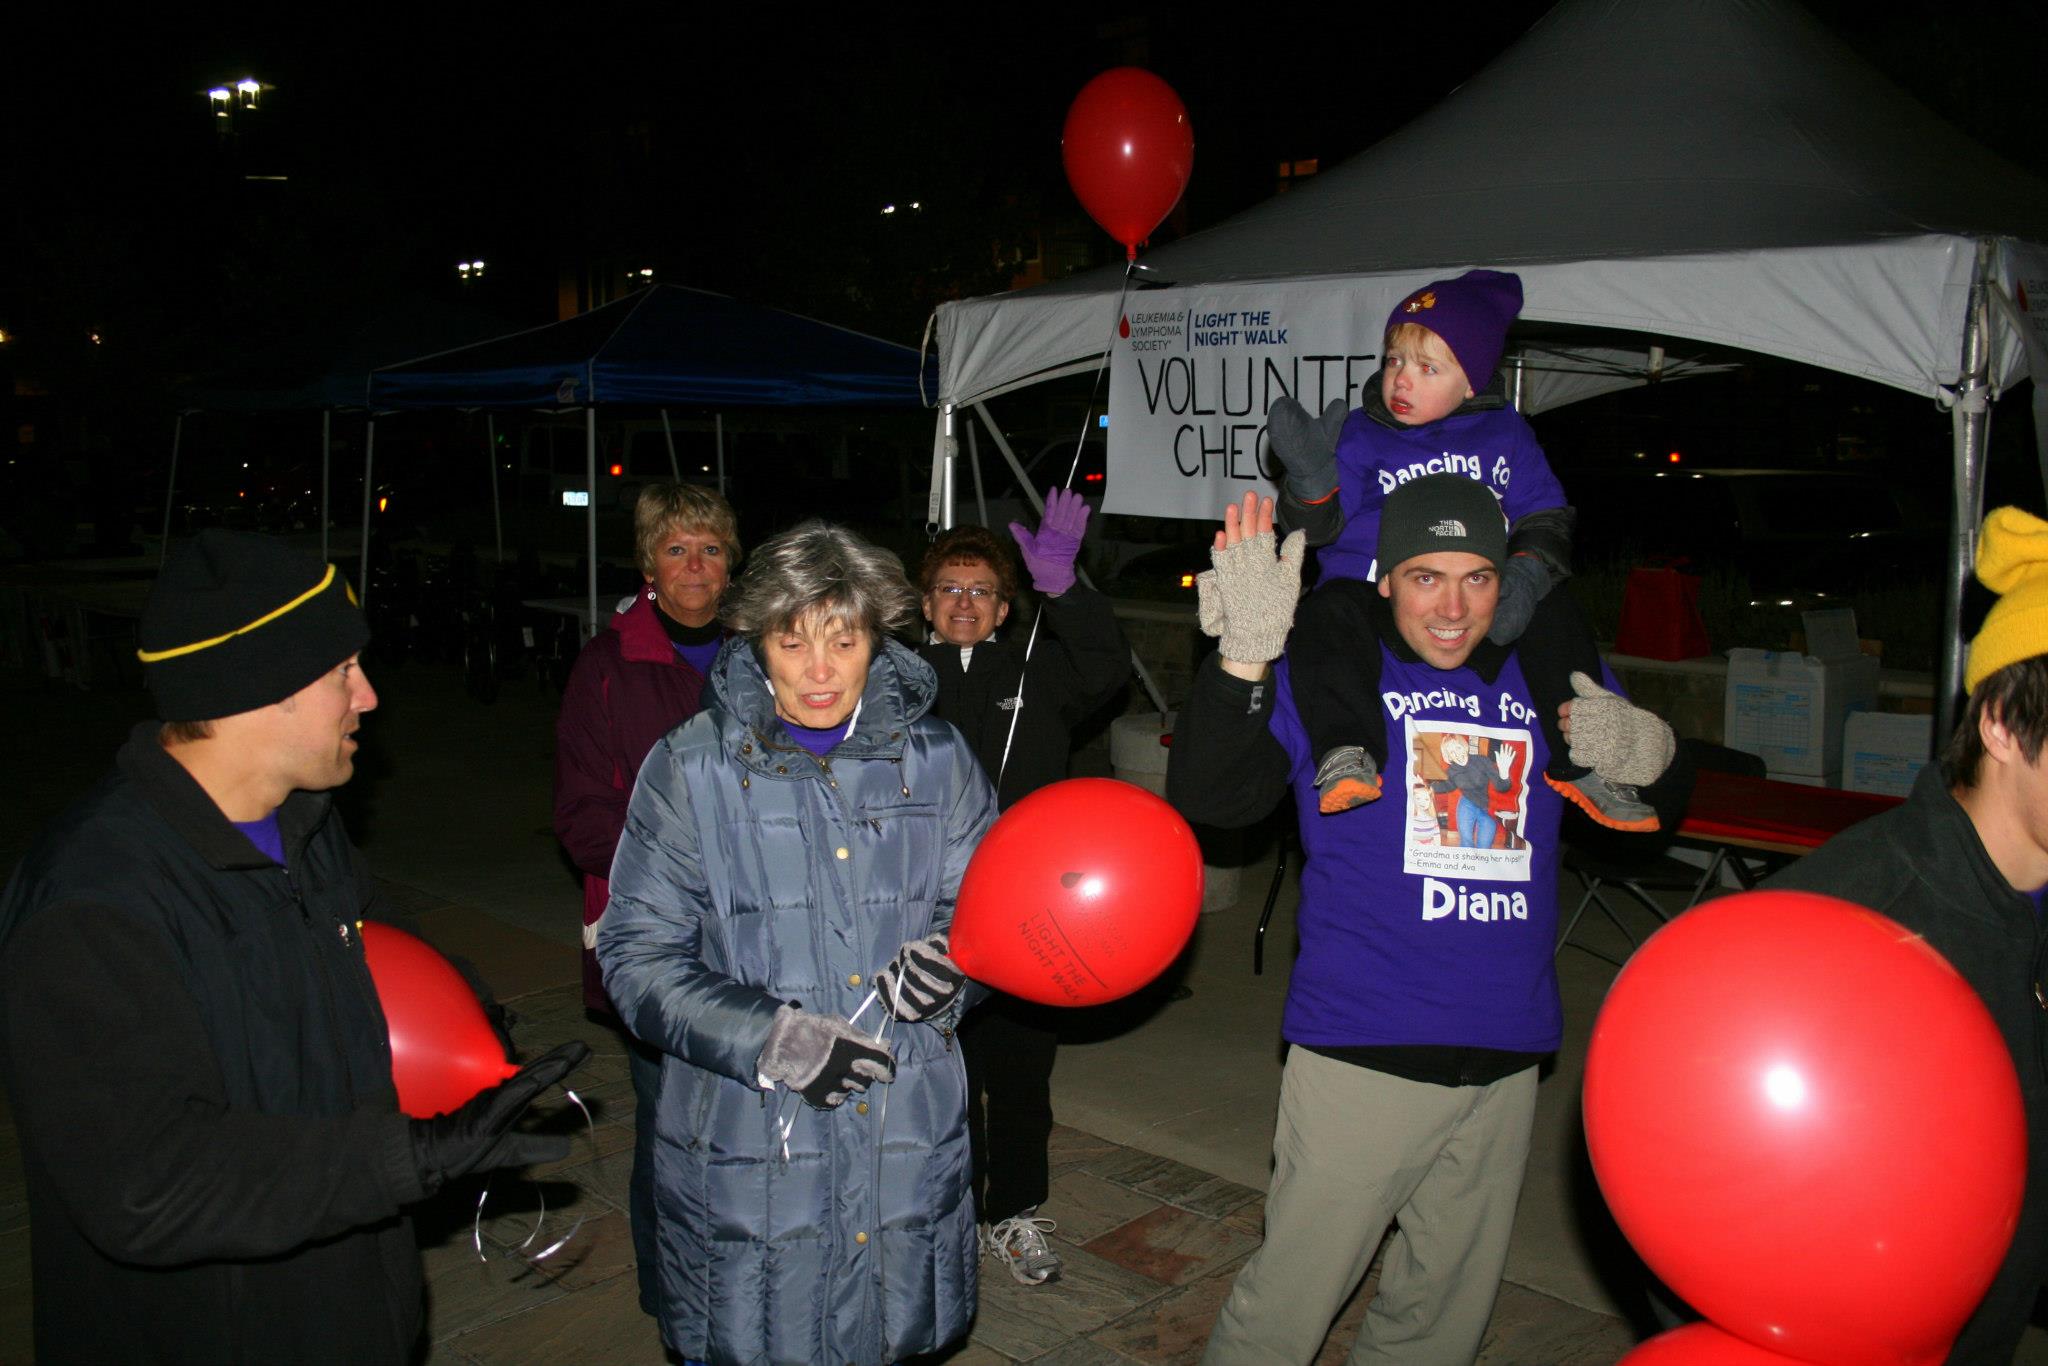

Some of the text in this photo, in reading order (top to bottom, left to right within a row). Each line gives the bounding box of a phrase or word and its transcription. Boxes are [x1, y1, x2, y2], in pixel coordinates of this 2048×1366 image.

[1132, 311, 1184, 324] LEUKEMIA &
[1195, 311, 1270, 328] LIGHT THE
[1132, 326, 1182, 338] LYMPHOMA
[1195, 329, 1288, 346] NIGHT WALK
[1378, 451, 1510, 495] Dancing fo
[1382, 687, 1537, 725] Dancing for
[1444, 861, 1458, 870] and
[1462, 863, 1476, 871] Ava
[1453, 852, 1459, 860] is
[1462, 853, 1489, 863] shaking
[1490, 855, 1502, 863] her
[1422, 877, 1527, 922] Diana
[1018, 922, 1054, 967] NIGHT
[1030, 913, 1087, 986] LIGHT THE
